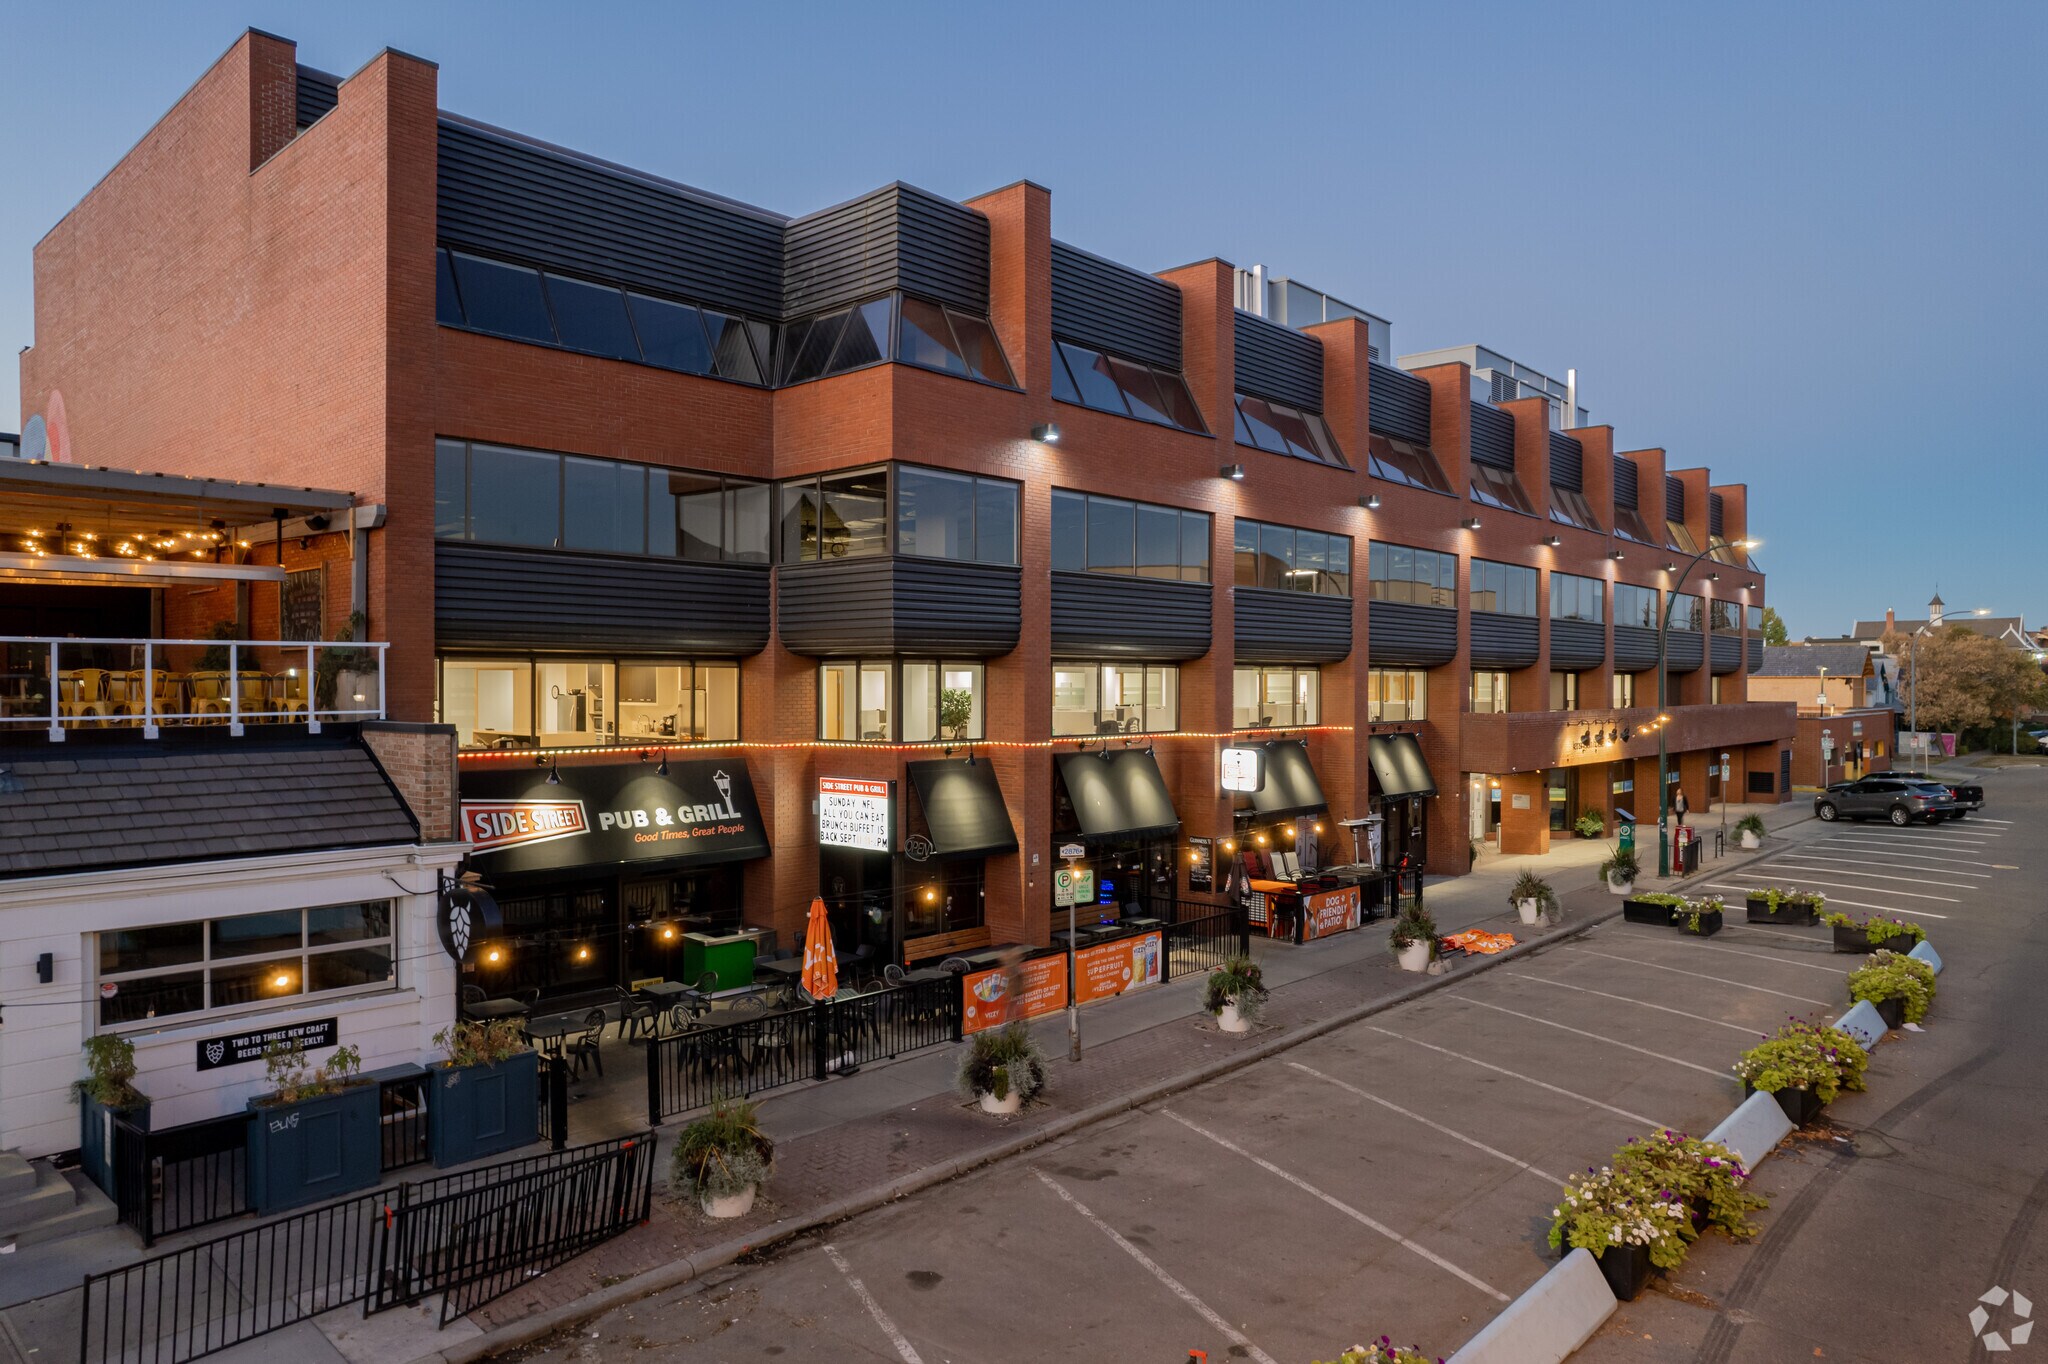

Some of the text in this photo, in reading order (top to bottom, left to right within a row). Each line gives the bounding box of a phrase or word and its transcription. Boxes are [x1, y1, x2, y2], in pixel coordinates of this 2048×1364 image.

[822, 782, 834, 790] SIDE
[835, 782, 852, 790] STREET
[853, 784, 864, 792] PUB
[870, 786, 885, 794] GRILL
[829, 797, 874, 810] SUNDAY NFL
[598, 802, 742, 830] PUB & GRILL
[824, 809, 884, 822] ALL YOU CAN EAT
[474, 810, 576, 839] SIDE STREET
[822, 820, 884, 835] BRUNCH BUFFET IS
[634, 824, 745, 843] Good Times, Great People
[820, 831, 838, 842] BACK
[840, 833, 856, 843] SEPT
[906, 840, 930, 857] OPEN
[1326, 896, 1340, 906] DOG
[1320, 904, 1347, 918] FRIENDLY
[1324, 915, 1343, 927] PATIO!
[1087, 960, 1124, 976] SUPERFRUIT
[985, 1010, 1000, 1018] VIZZY
[232, 1023, 329, 1048] TWO TO THREE NEW CRAFT
[238, 1048, 262, 1059] BEERS
[263, 1041, 291, 1053] TAPED
